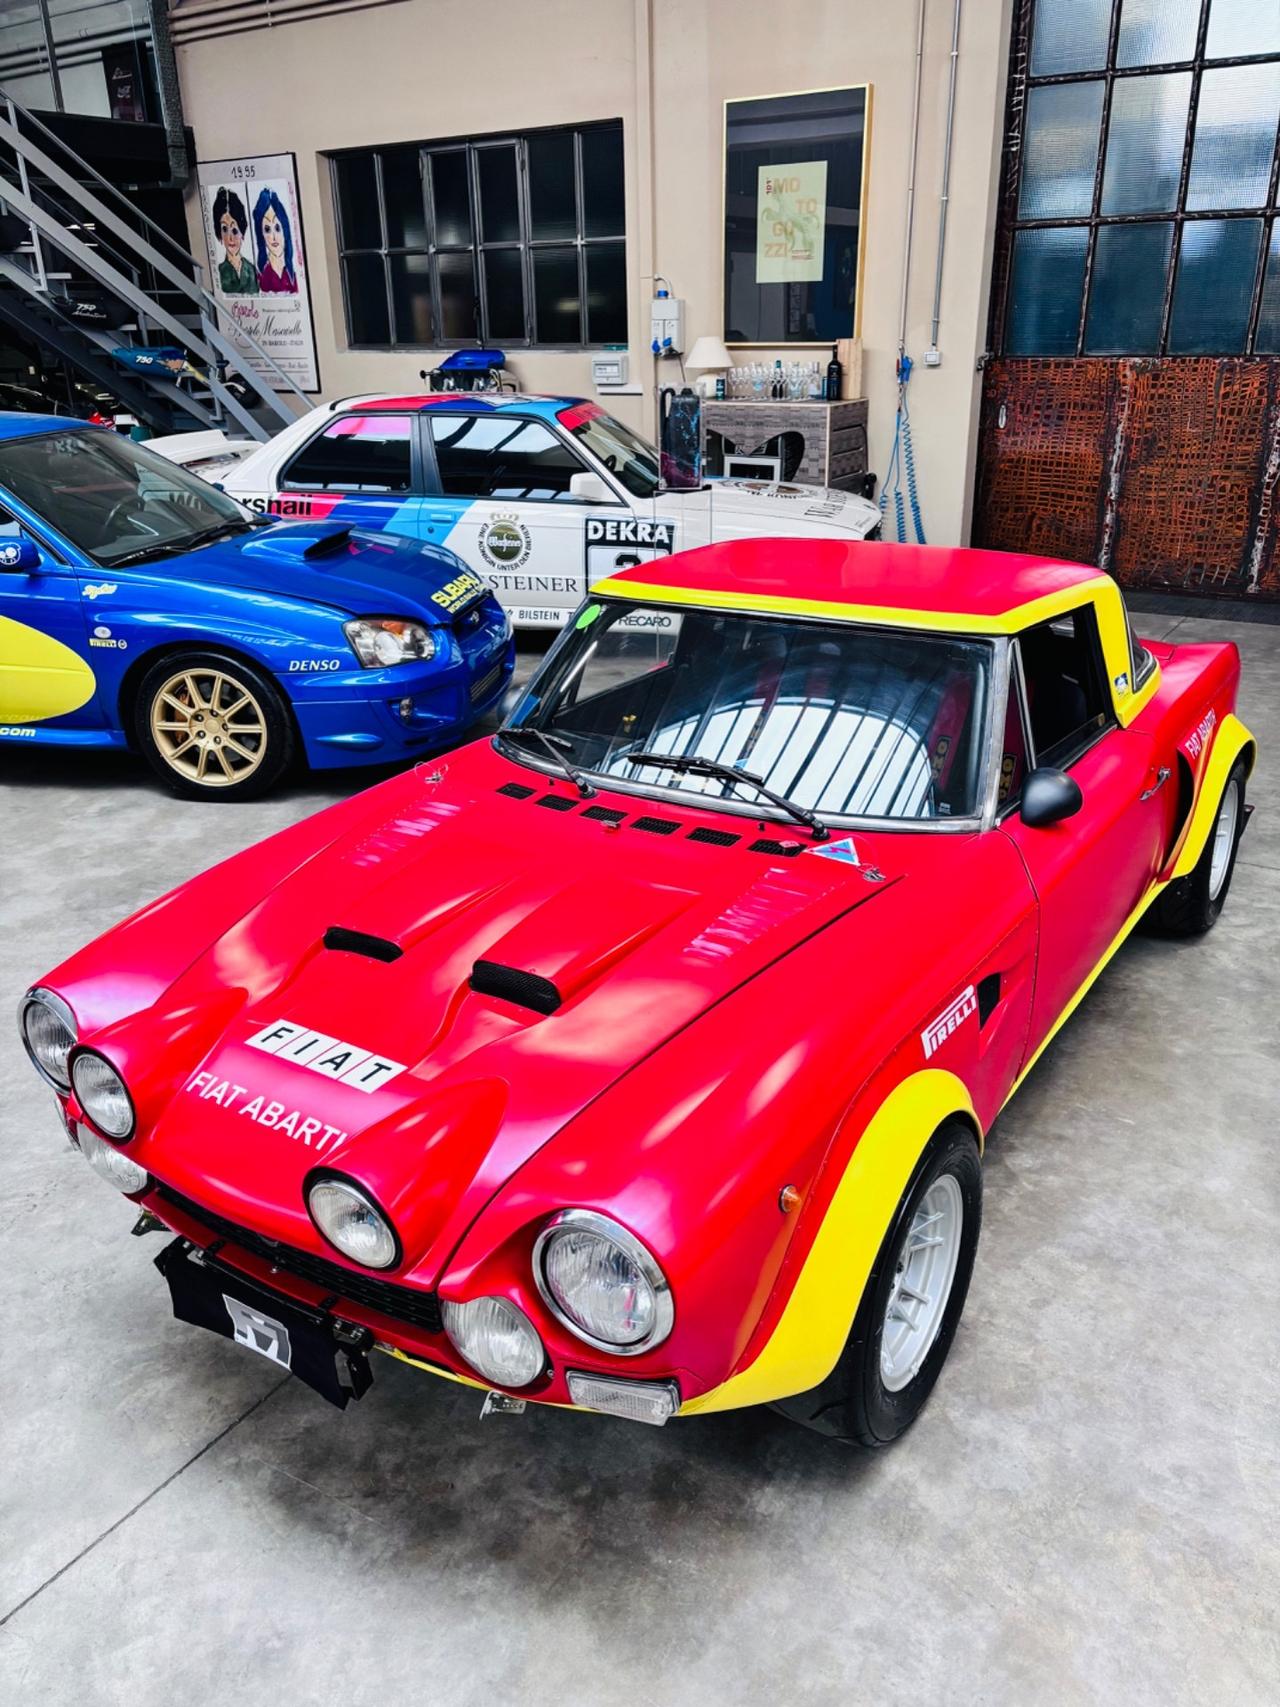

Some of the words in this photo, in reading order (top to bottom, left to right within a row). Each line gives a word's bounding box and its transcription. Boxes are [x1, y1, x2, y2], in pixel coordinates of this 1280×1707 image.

[796, 198, 818, 214] TO
[76, 303, 97, 312] 750
[136, 355, 154, 365] 750
[588, 520, 671, 544] DEKRA
[496, 562, 521, 571] UNTER
[488, 574, 578, 593] STEINER
[518, 610, 560, 621] BILSTEIN
[618, 616, 672, 628] RECARO
[288, 659, 340, 671] DENSO
[920, 984, 977, 1060] PIRELLI
[260, 1026, 392, 1083] FIAT
[185, 1071, 248, 1109] FIAT
